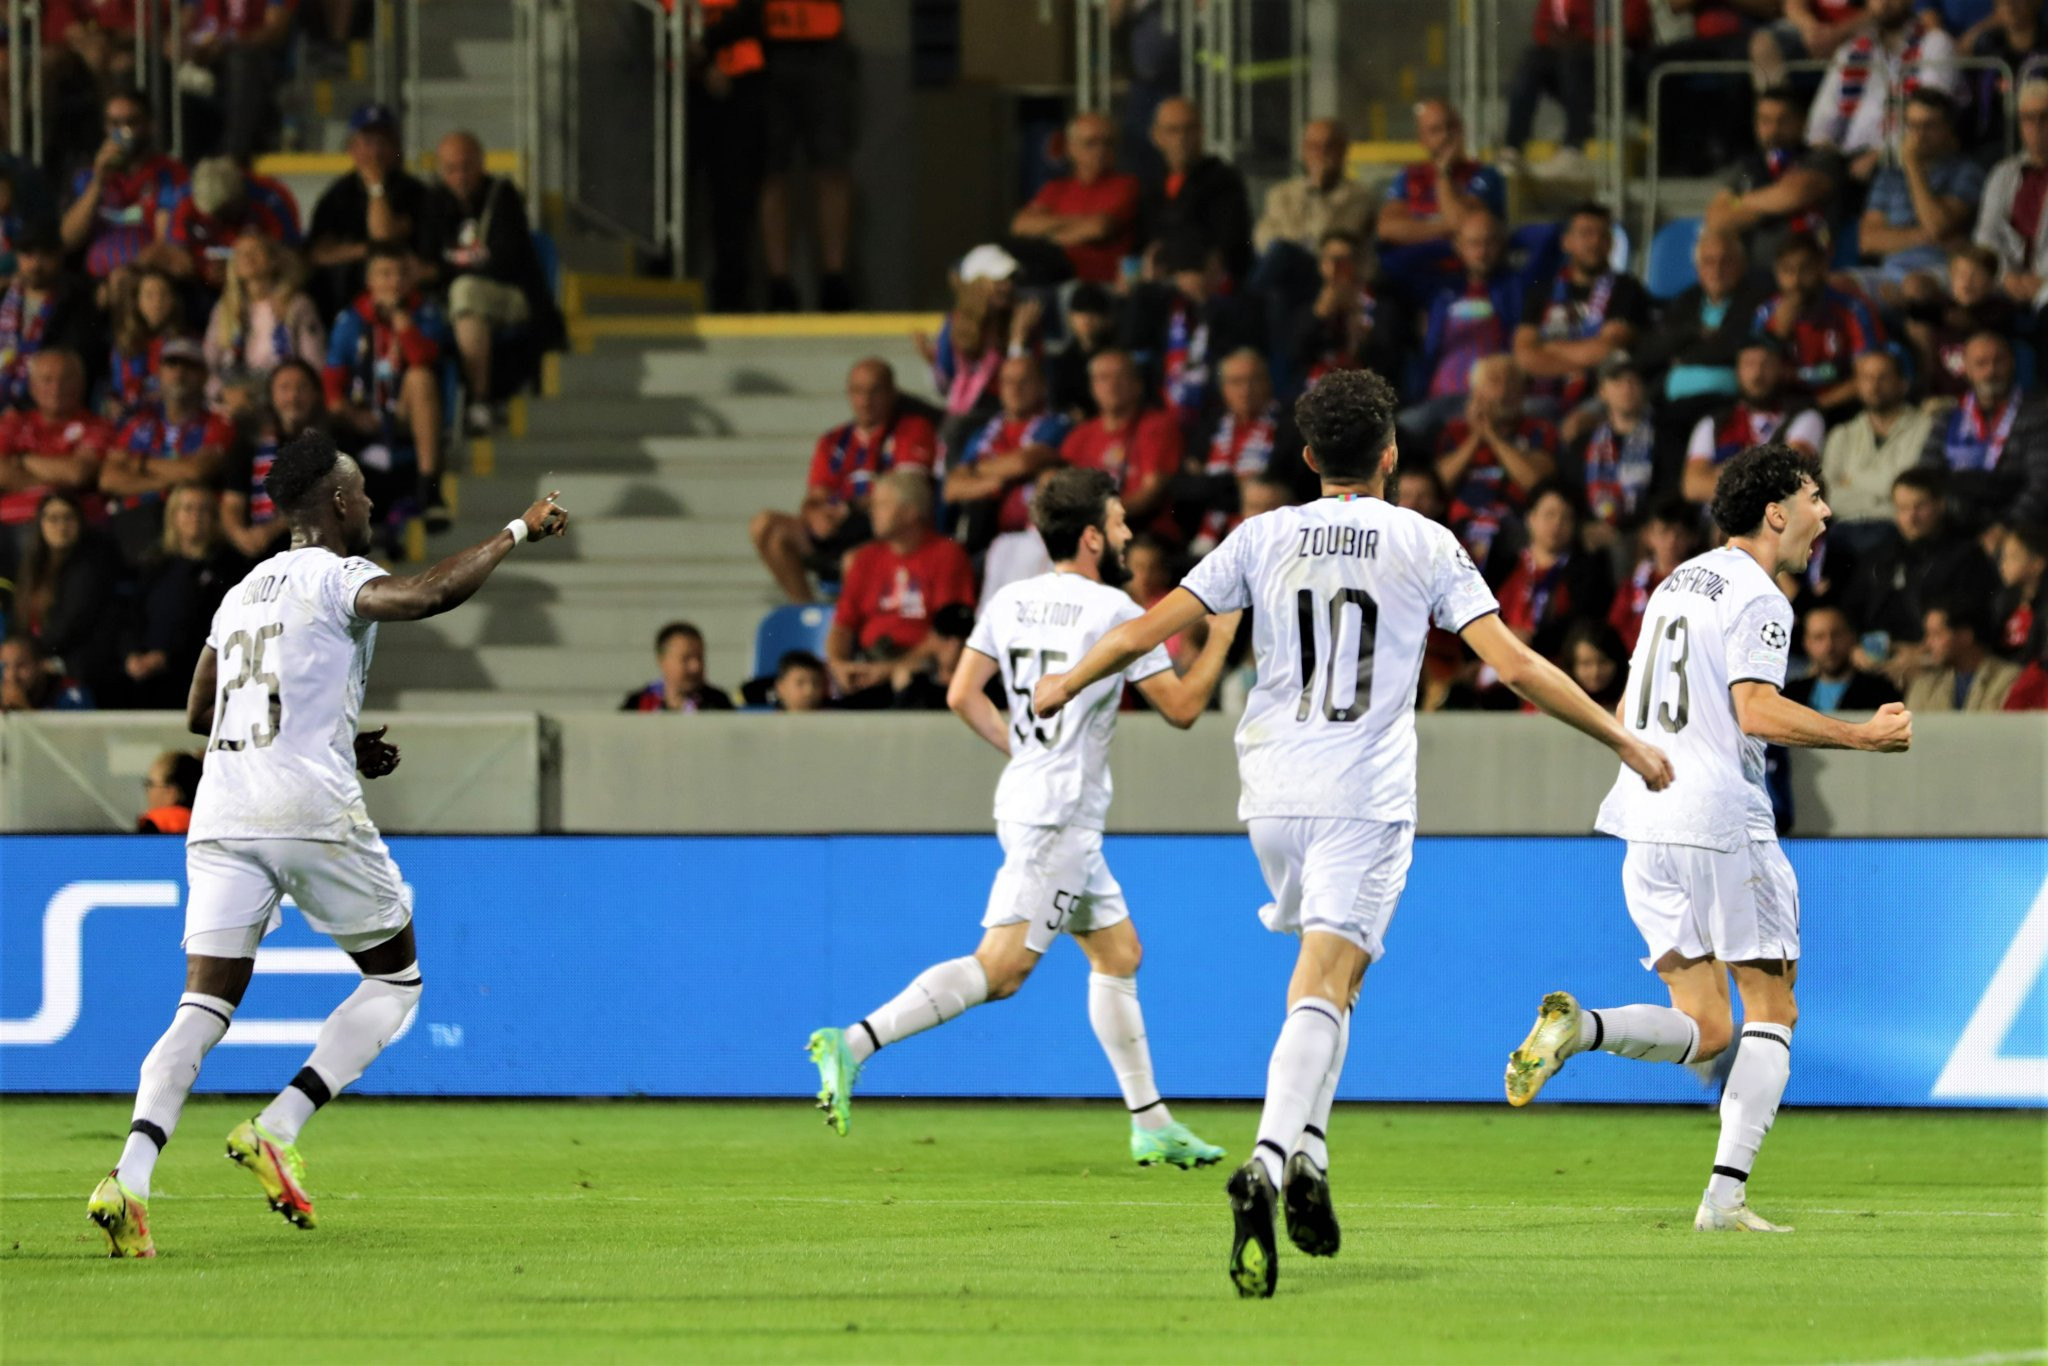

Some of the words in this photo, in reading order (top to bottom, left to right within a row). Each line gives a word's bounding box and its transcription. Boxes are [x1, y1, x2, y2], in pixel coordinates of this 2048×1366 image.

[1298, 525, 1380, 560] ZOUBIR
[208, 622, 284, 752] 25
[1296, 587, 1379, 722] 10
[1635, 615, 1690, 734] 13
